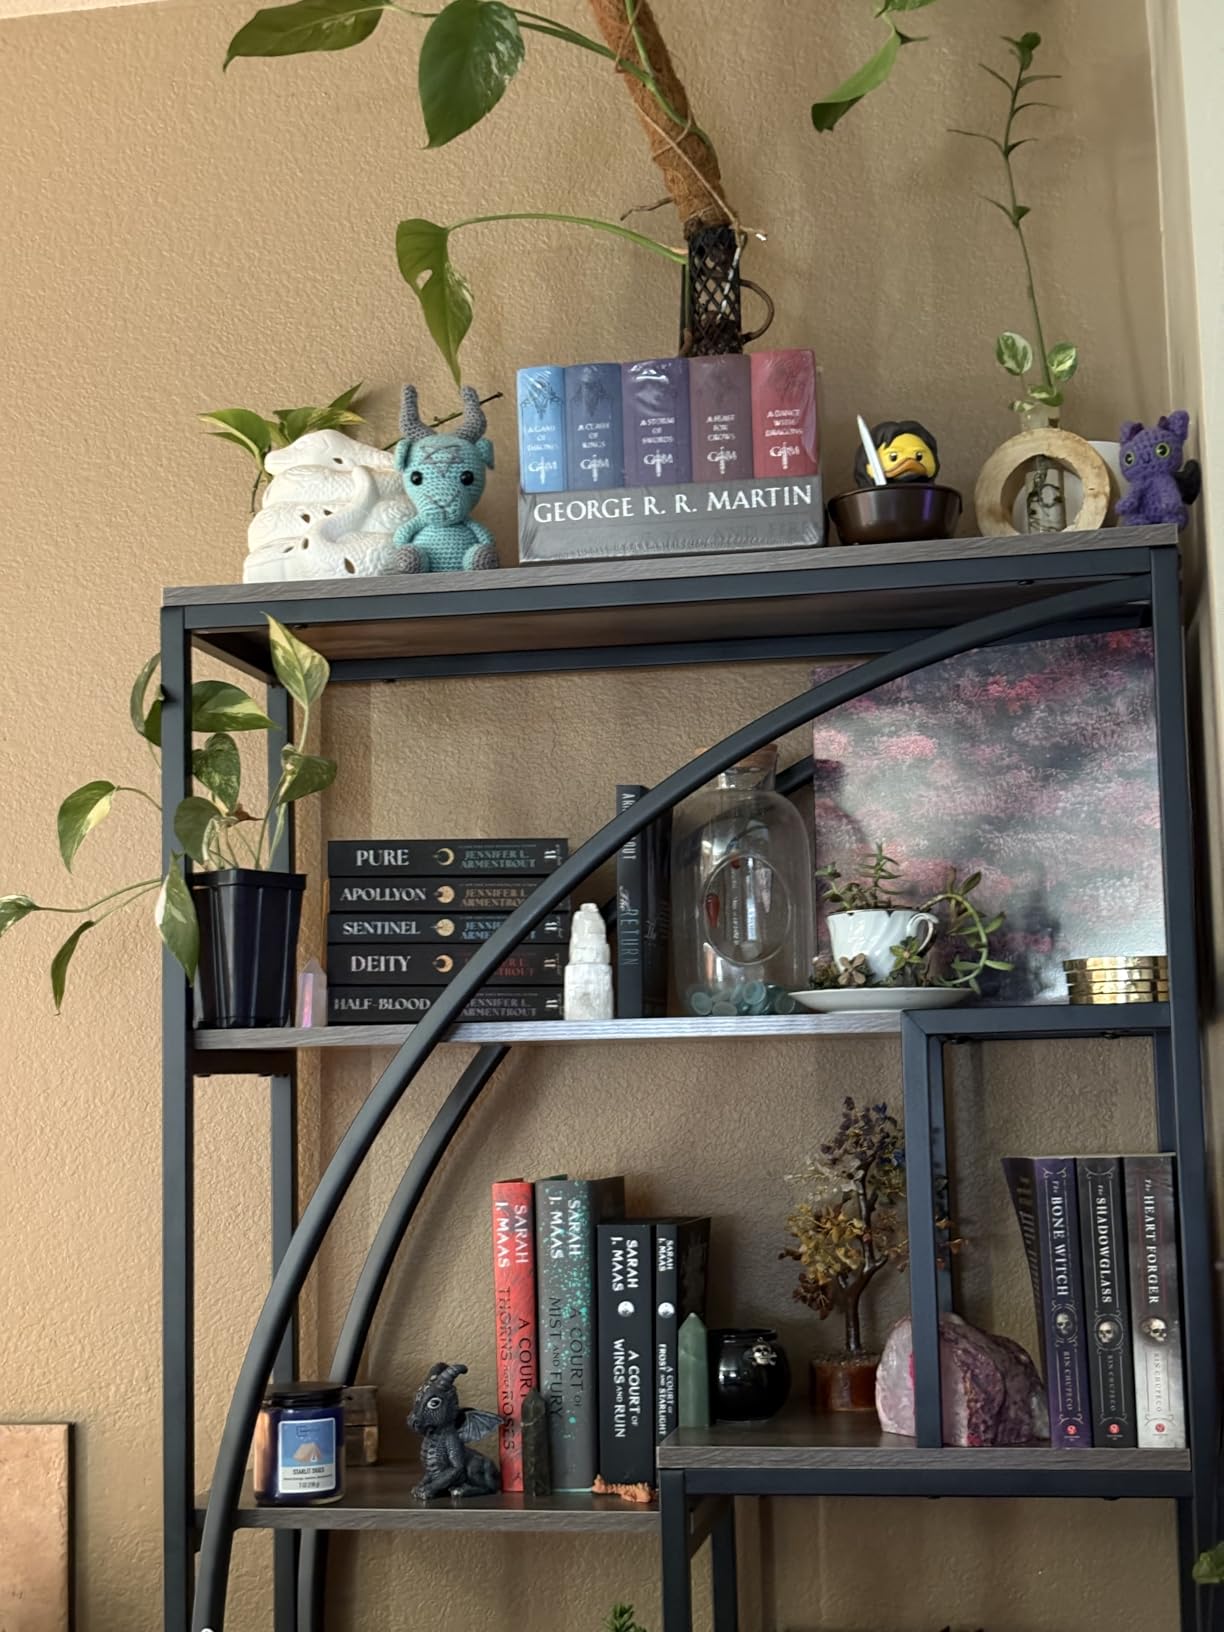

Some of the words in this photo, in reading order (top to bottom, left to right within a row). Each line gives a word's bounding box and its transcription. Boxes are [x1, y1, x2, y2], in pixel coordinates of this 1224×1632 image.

[533, 498, 632, 523] GEORGE
[644, 497, 666, 514] R.
[675, 495, 696, 513] R.
[707, 485, 812, 511] MARTIN
[356, 850, 409, 866] PURE
[461, 860, 536, 869] ARMENTROUT
[464, 850, 517, 859] JENNIFER
[519, 850, 529, 859] L.
[340, 887, 426, 902] APOLLYON
[465, 889, 519, 897] JENNIFER
[343, 921, 421, 935] SENTINEL
[620, 908, 640, 966] RETURN
[351, 956, 411, 973] DEITY
[334, 998, 431, 1010] HALF-BLOOD
[461, 1008, 537, 1017] ARMENTROUT
[496, 1202, 508, 1210] J.
[549, 1196, 562, 1206] J.
[1050, 1196, 1065, 1239] BONE
[1143, 1195, 1156, 1241] HEART
[497, 1216, 510, 1268] MAAS
[515, 1205, 527, 1264] SARAH
[551, 1212, 563, 1259] MAAS
[568, 1199, 580, 1256] SARAH
[611, 1237, 623, 1246] J.
[612, 1250, 624, 1291] MAAS
[626, 1239, 638, 1288] SARAH
[1054, 1244, 1068, 1296] WITCH
[1096, 1198, 1112, 1304] SHADOWGLASS
[1146, 1245, 1159, 1304] FORGER
[499, 1286, 512, 1361] THORNS
[519, 1318, 530, 1330] A
[549, 1298, 562, 1340] MIST
[570, 1308, 581, 1319] A
[552, 1346, 561, 1367] AND
[569, 1328, 584, 1391] COURT
[613, 1339, 625, 1384] WINGS
[628, 1350, 639, 1361] A
[658, 1344, 666, 1371] FROST
[1064, 1351, 1072, 1367] RIN
[549, 1372, 562, 1418] FURY
[628, 1365, 640, 1414] COURT
[1064, 1369, 1074, 1411] CHUPECO
[1154, 1371, 1163, 1412] CHUPECO
[502, 1391, 515, 1450] ROSES
[614, 1404, 626, 1438] RUIN
[631, 1416, 639, 1427] OF
[658, 1388, 667, 1436] STARLIGHT
